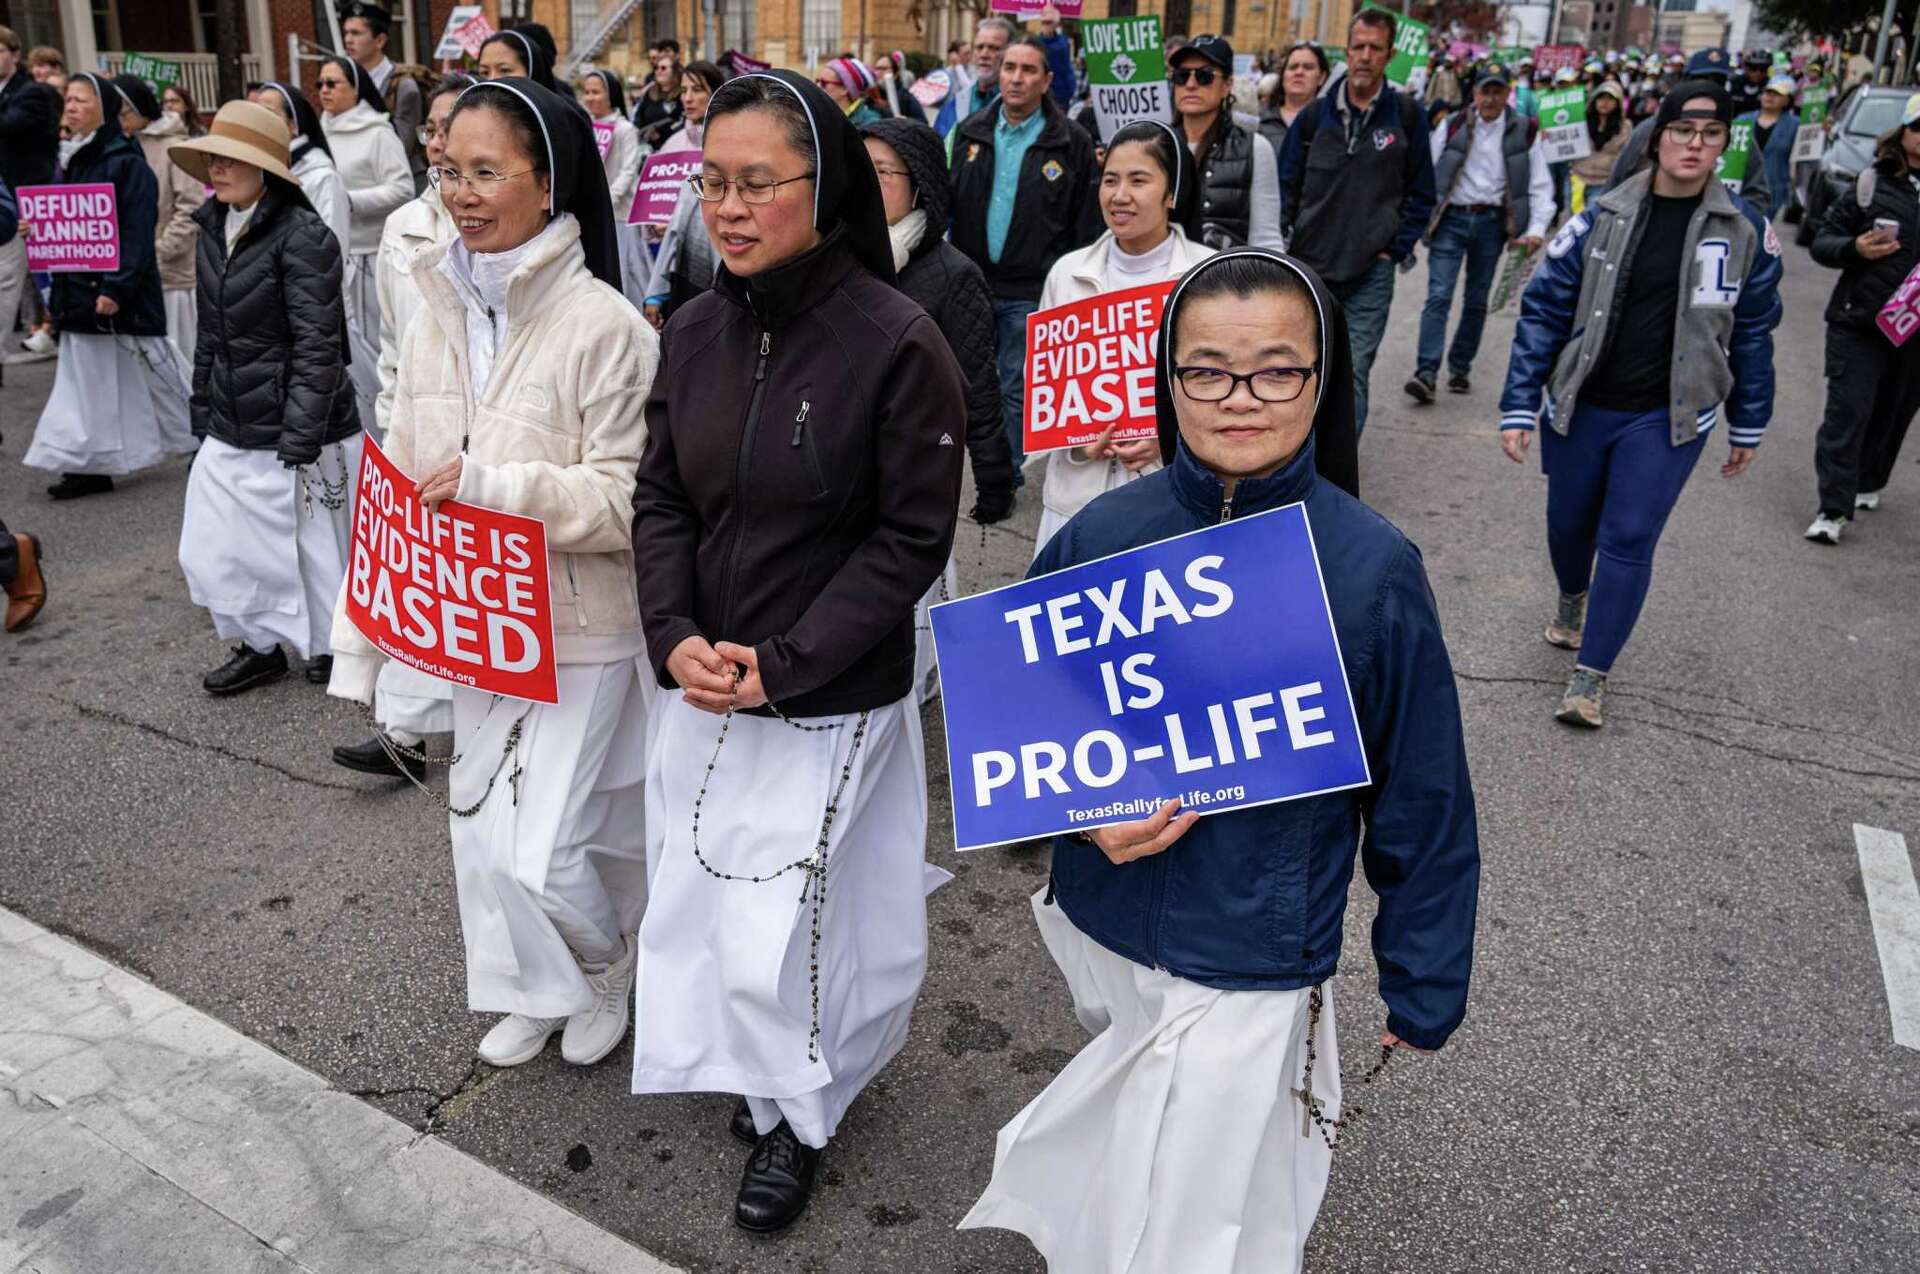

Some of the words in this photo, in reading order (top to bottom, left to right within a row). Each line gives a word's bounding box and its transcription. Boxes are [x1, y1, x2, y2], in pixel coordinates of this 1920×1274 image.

[1084, 23, 1122, 53] LOVE
[1123, 19, 1159, 51] LIFE
[1098, 86, 1161, 115] CHOOSE
[20, 192, 112, 220] DEFUND
[27, 243, 115, 259] PARENTHOOD
[1034, 298, 1154, 350] PRO-LIFE
[1032, 330, 1159, 384] EVIDEN
[1031, 367, 1156, 432] BASE
[362, 453, 477, 560] PRO-LIFE
[489, 527, 532, 569] IS
[356, 493, 537, 617] EVIDENCE
[351, 538, 542, 674] BASED
[1004, 555, 1235, 664] TEXAS
[377, 635, 477, 686] TexasRallyforLife.org
[1100, 652, 1165, 716] IS
[972, 681, 1335, 808] PRO-LIFE
[1066, 785, 1246, 824] TexasRallyfLife.org
